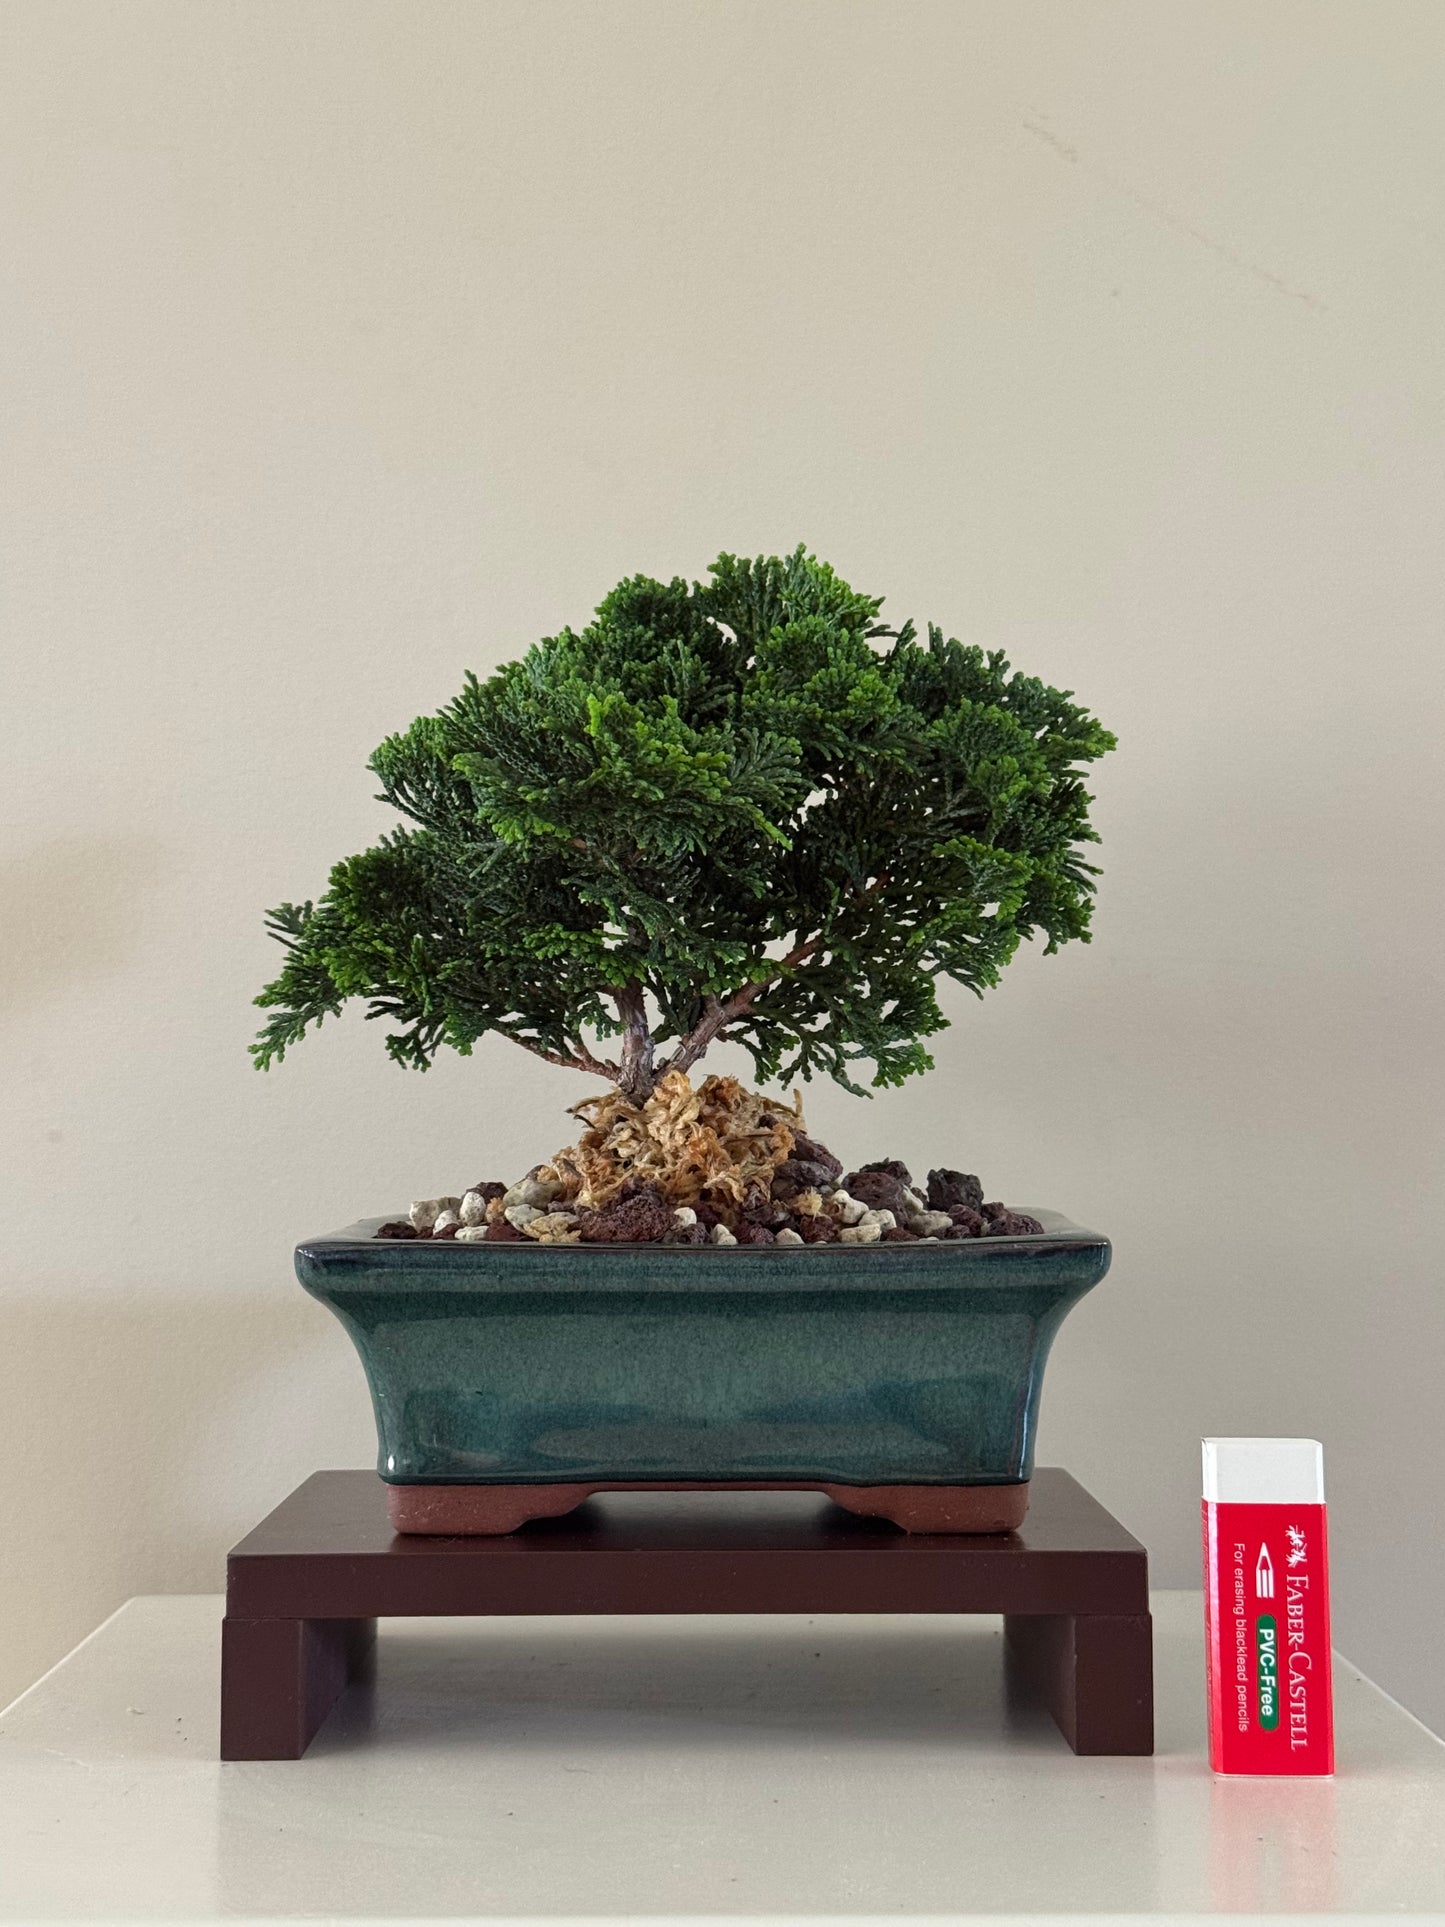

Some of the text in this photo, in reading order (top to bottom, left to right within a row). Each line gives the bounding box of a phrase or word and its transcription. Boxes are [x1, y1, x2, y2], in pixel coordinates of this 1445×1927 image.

[1233, 1543, 1249, 1732] For erasing blacklead pencils
[1259, 1628, 1275, 1716] PVC-Free
